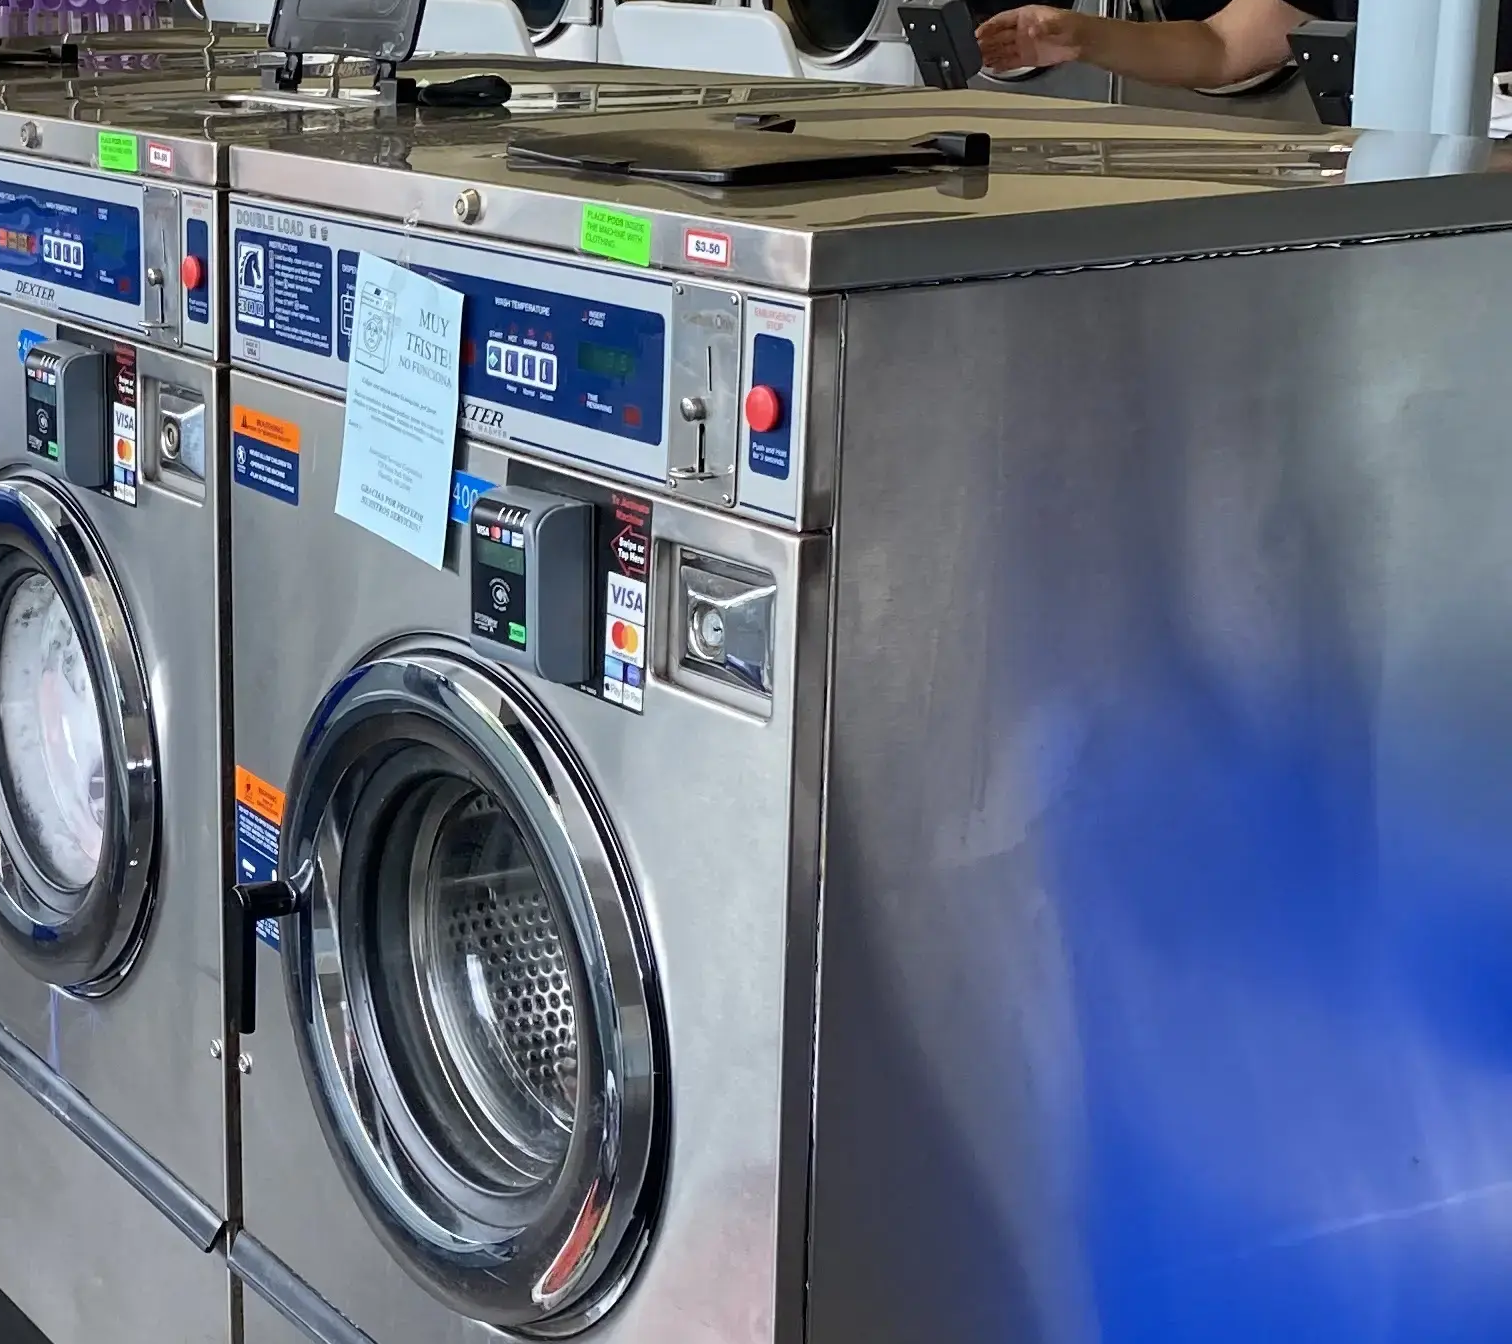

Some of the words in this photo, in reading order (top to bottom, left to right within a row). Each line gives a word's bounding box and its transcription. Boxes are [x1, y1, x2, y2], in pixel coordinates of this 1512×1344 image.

[236, 208, 275, 231] DOUBLE
[277, 217, 304, 237] LOAD
[695, 240, 721, 256] $3.50
[15, 280, 55, 301] DEXTER
[419, 308, 450, 337] MUY
[406, 331, 452, 370] TRISTE!
[398, 355, 411, 370] NO
[412, 361, 452, 389] FUNCIONA
[115, 411, 134, 430] VISA
[458, 401, 504, 429] XTER
[360, 483, 385, 502] GRACIAS
[385, 494, 397, 507] POR
[618, 547, 629, 562] Tap
[611, 583, 644, 613] VISA
